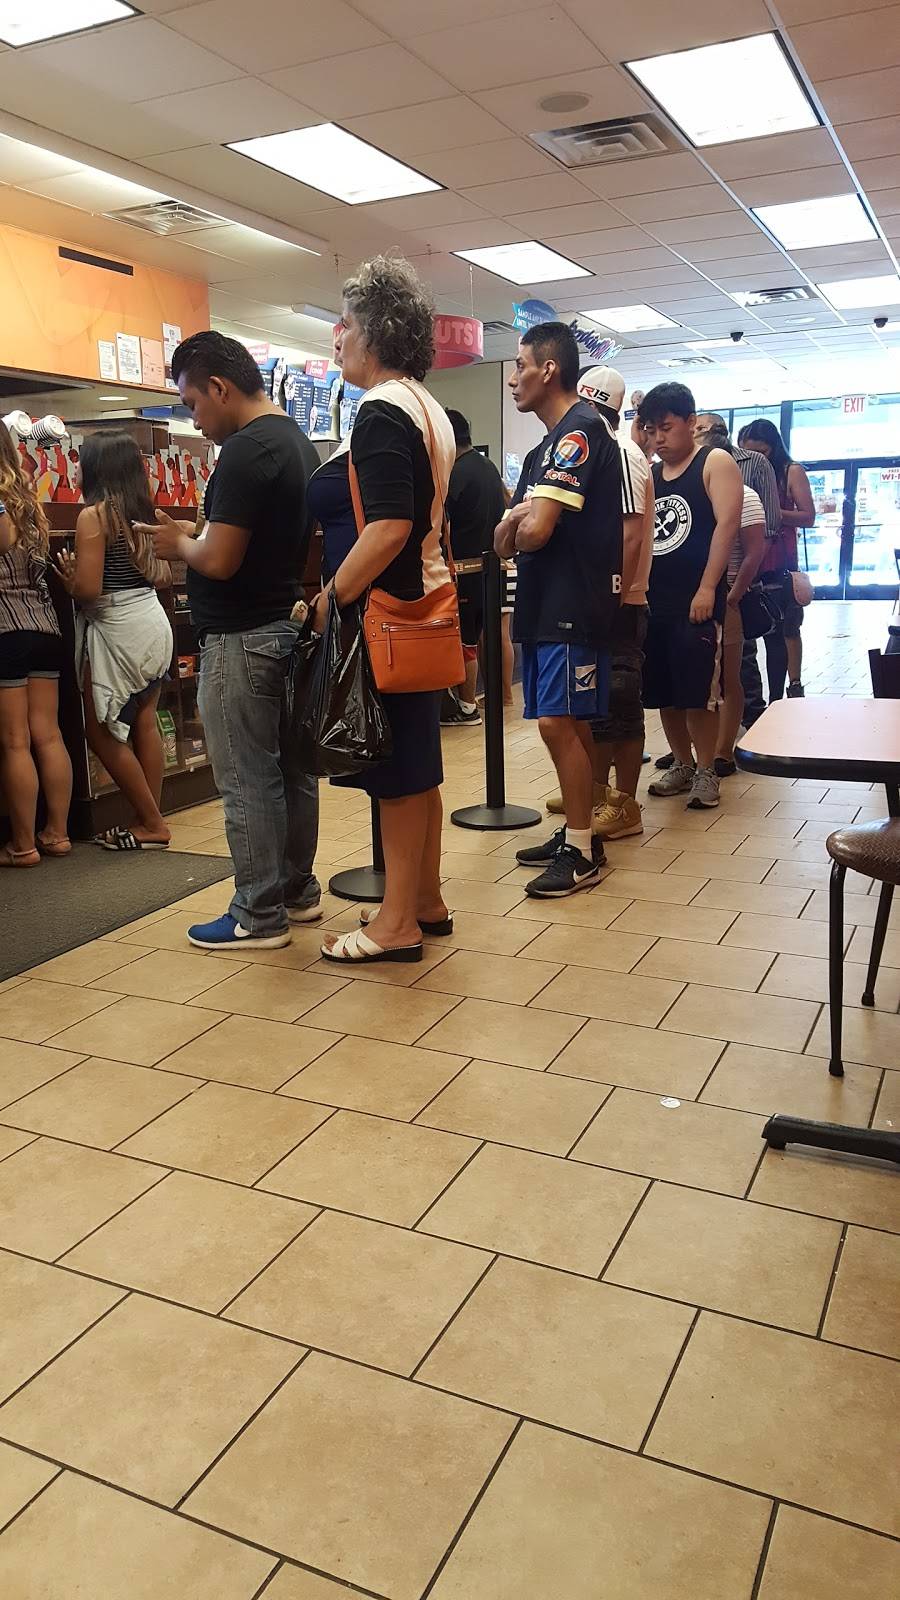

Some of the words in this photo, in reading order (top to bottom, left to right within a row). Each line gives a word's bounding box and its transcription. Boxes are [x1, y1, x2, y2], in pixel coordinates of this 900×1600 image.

[436, 320, 474, 346] UTS
[844, 397, 865, 413] EXIT
[544, 468, 581, 487] TOTAL
[881, 473, 900, 481] WI-
